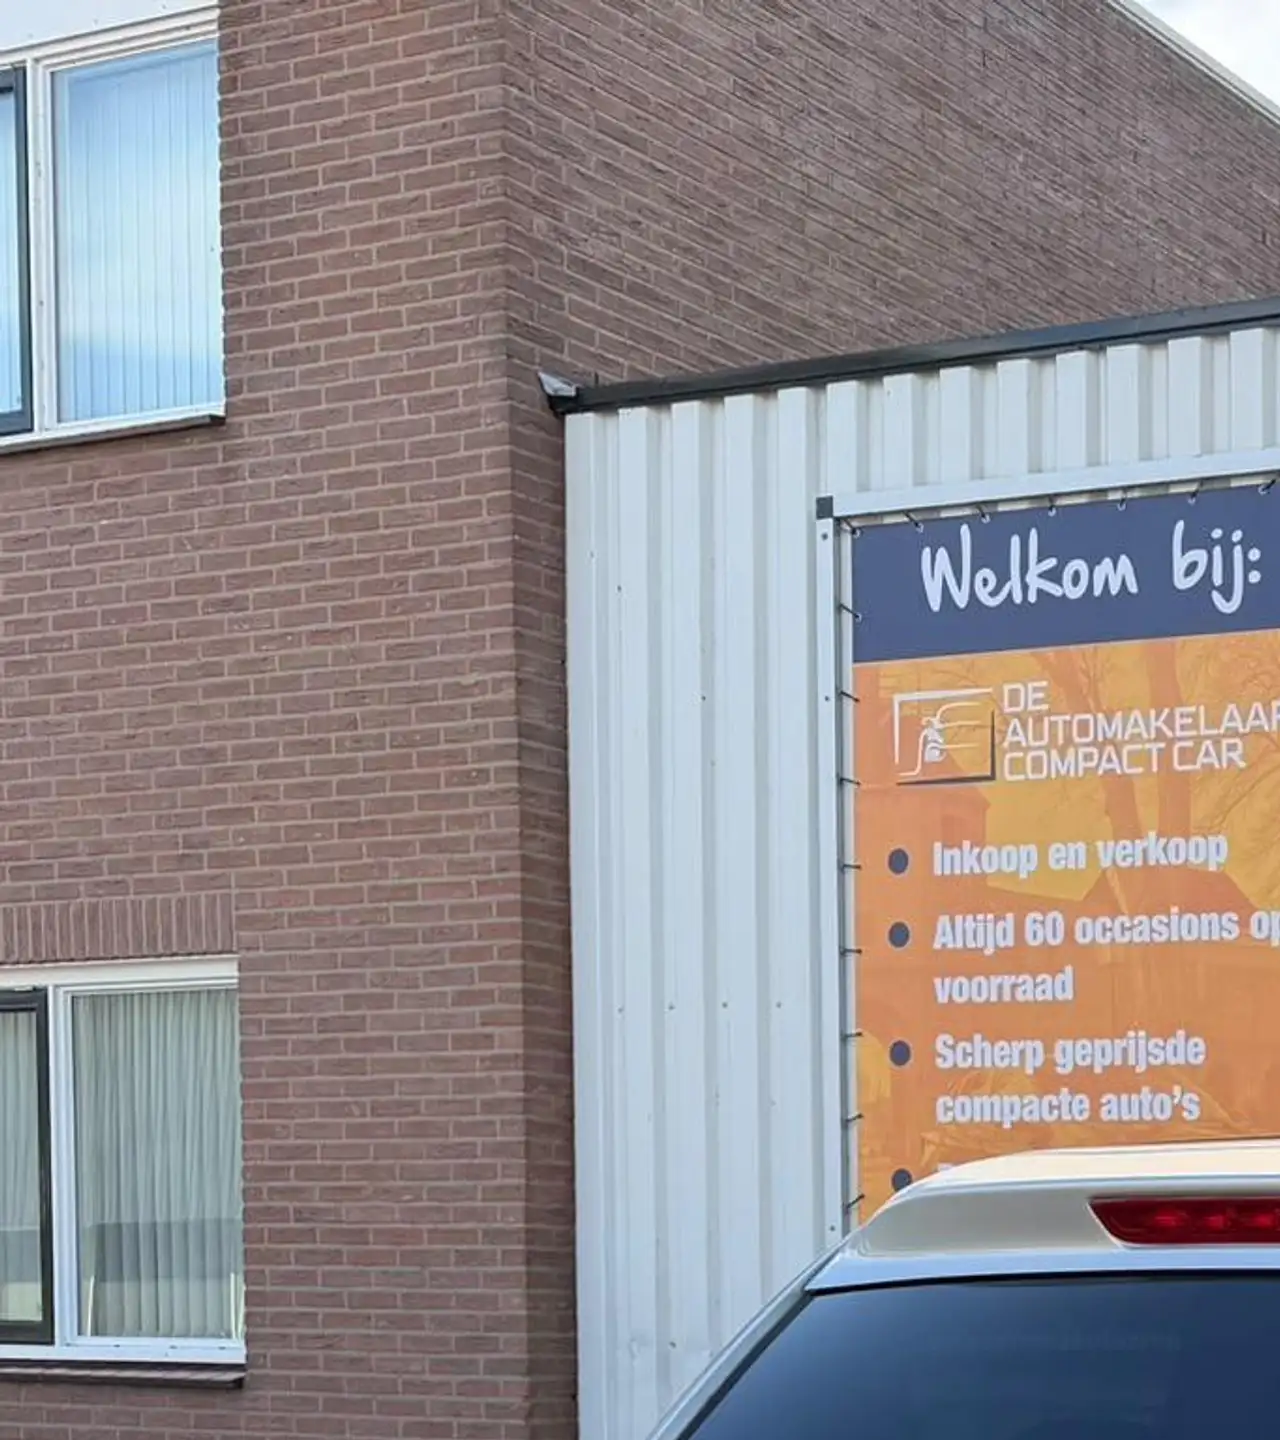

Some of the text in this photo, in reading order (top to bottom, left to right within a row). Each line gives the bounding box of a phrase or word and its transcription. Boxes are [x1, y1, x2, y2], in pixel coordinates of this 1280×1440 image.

[921, 519, 1261, 614] Welkom bij:
[1002, 681, 1049, 714] DE
[1003, 739, 1246, 782] COMPACT CAR
[933, 831, 1228, 878] Inkoop en verkoop
[934, 913, 1014, 955] Altijd
[1025, 910, 1064, 946] 60
[1075, 907, 1240, 944] occasions
[934, 966, 1074, 1002] voorraad
[936, 1030, 1205, 1074] Scherp geprijsde
[936, 1086, 1200, 1129] compacte auto's
